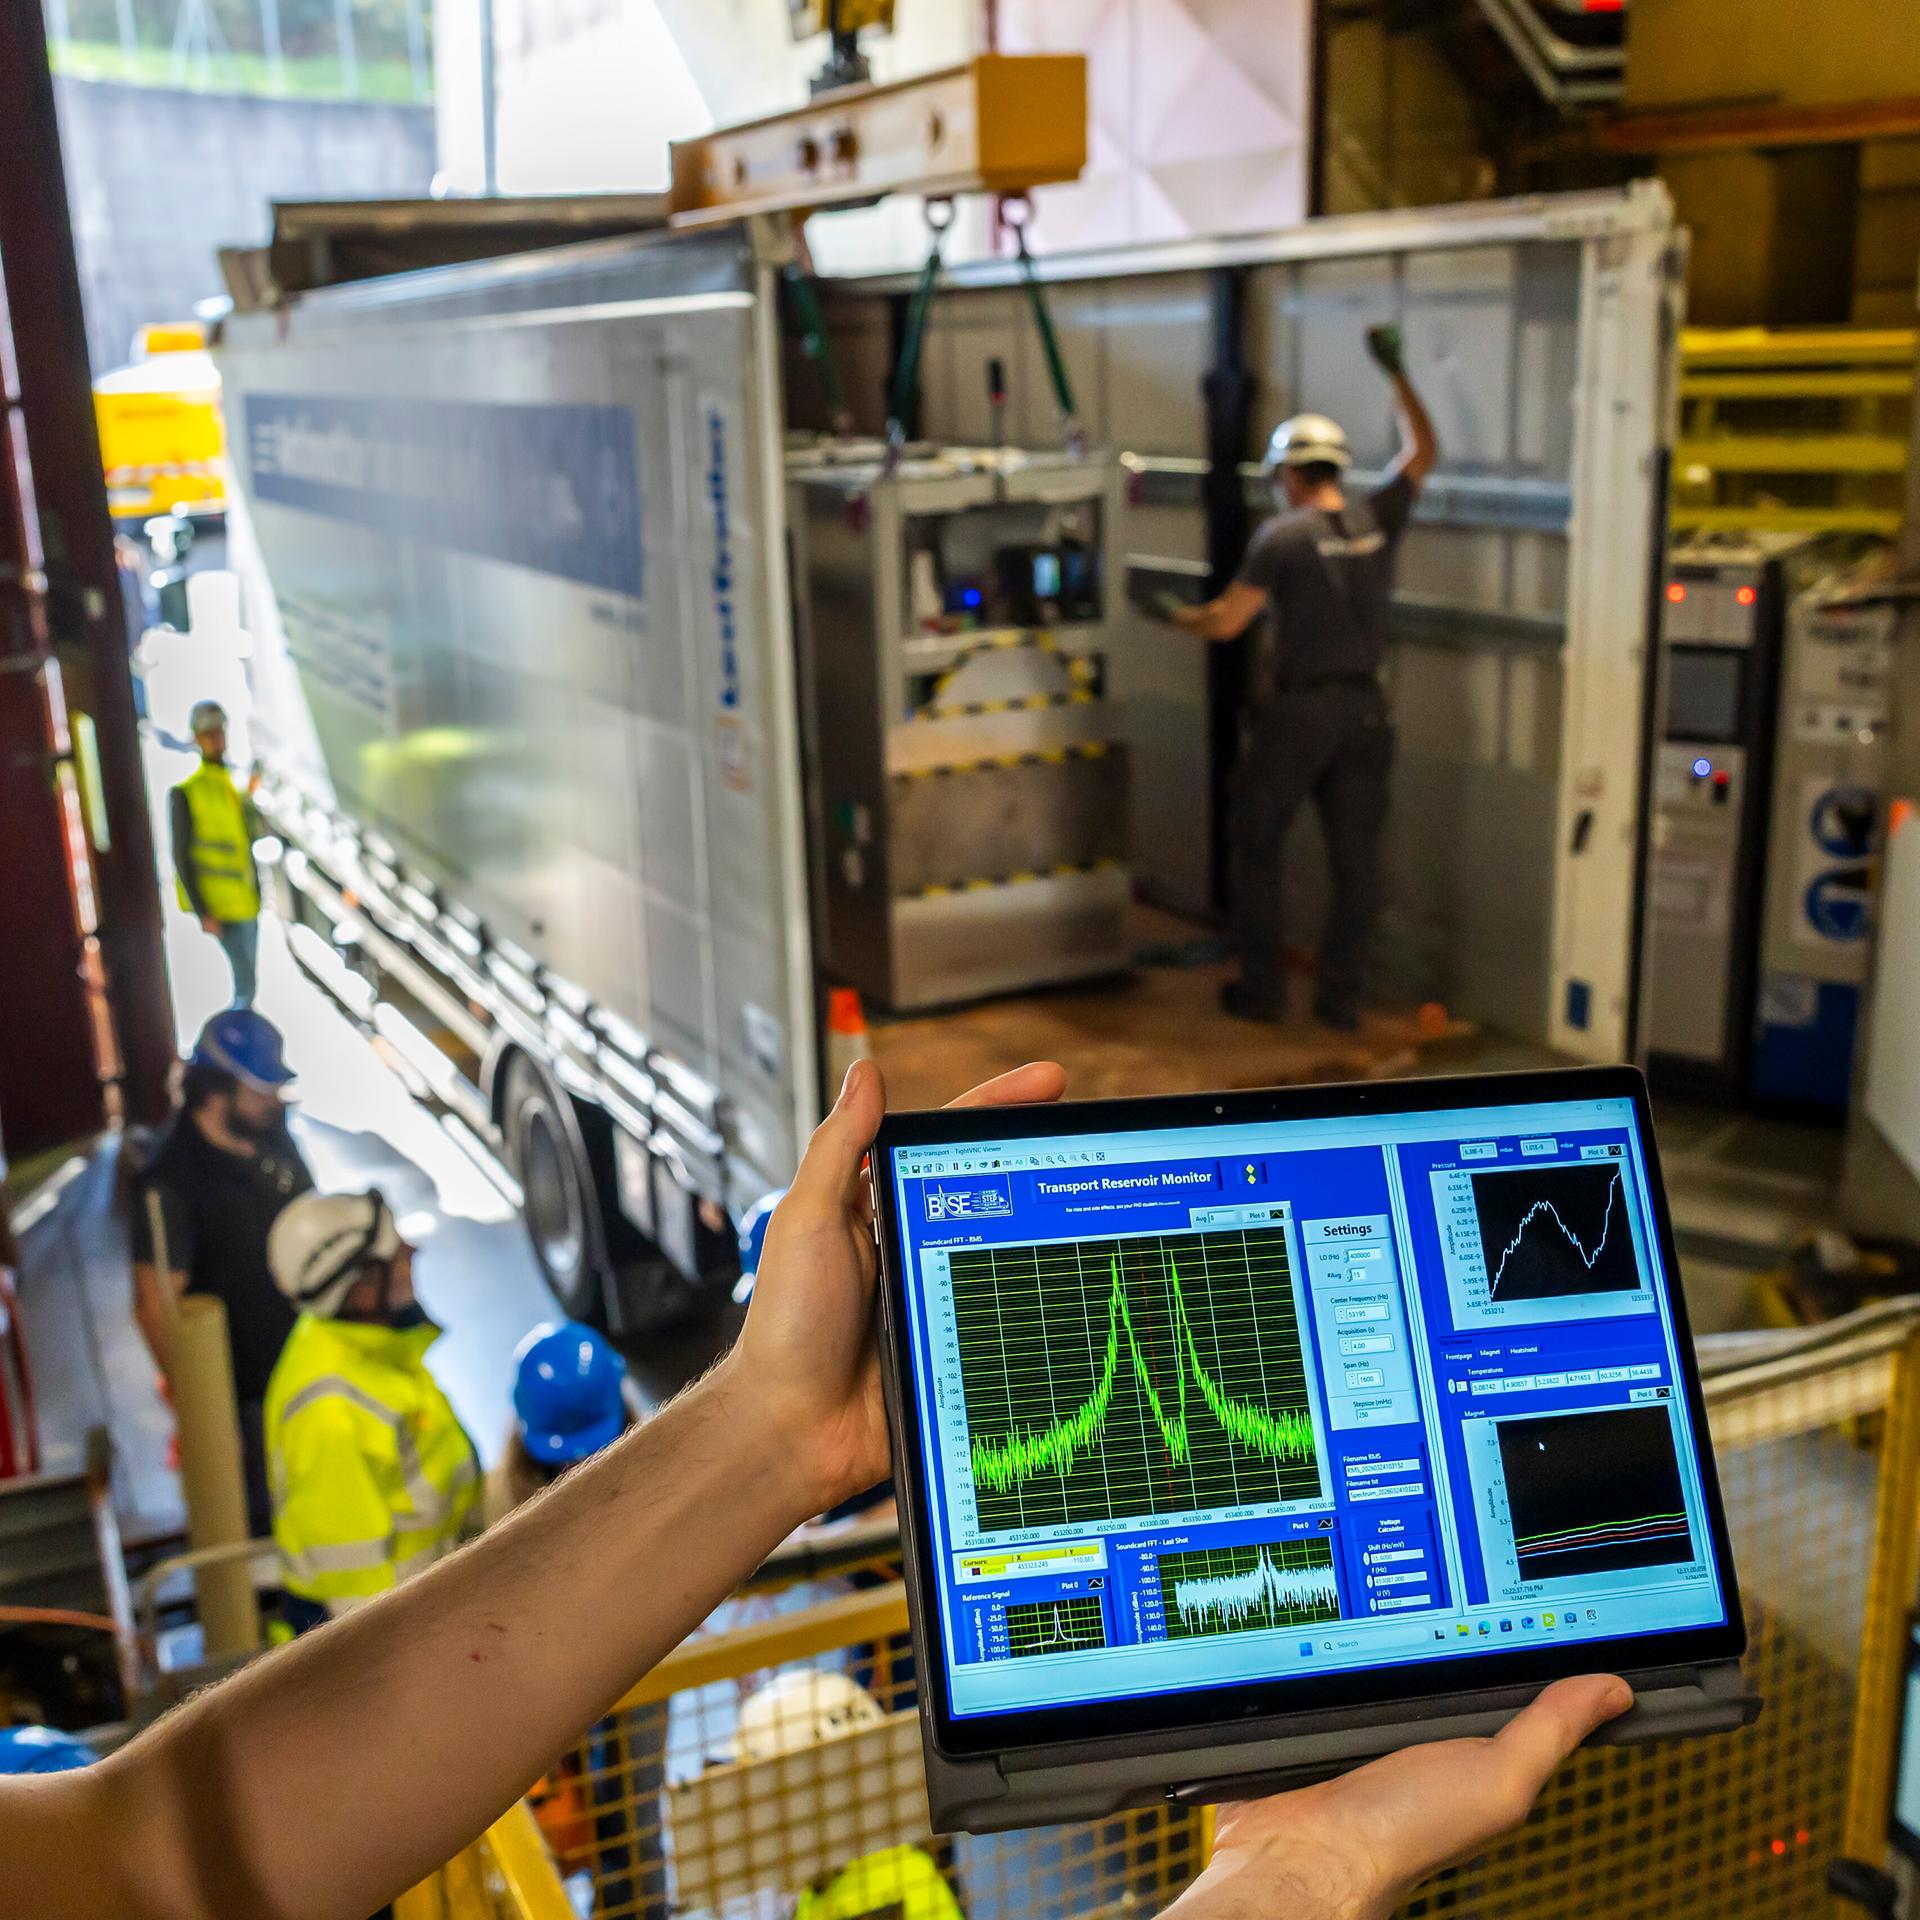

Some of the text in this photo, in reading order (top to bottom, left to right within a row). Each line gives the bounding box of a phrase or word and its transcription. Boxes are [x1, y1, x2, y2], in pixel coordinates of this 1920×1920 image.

[909, 1148, 949, 1157] step-transport
[954, 1146, 980, 1155] TightVNC
[1431, 1161, 1456, 1169] Pressure
[1037, 1170, 1212, 1196] Transport Reservoir Monitor
[981, 1194, 998, 1203] STEP
[1195, 1215, 1207, 1223] Avg
[1322, 1221, 1373, 1239] Settings
[921, 1237, 952, 1246] Soundcard
[953, 1236, 964, 1244] FFT
[1445, 1224, 1457, 1256] Amplitude
[1327, 1253, 1340, 1261] (Hz)
[1458, 1253, 1480, 1261] 6.05E-9
[1326, 1271, 1342, 1280] #Avg
[1330, 1296, 1348, 1304] Center
[1348, 1294, 1377, 1303] Frequency
[1348, 1310, 1366, 1318] 53195
[1481, 1307, 1505, 1315] 1253212
[1336, 1327, 1367, 1336] Acquisition
[1479, 1348, 1501, 1357] Magnet
[1509, 1345, 1538, 1354] Heatshield
[1444, 1351, 1473, 1362] Frontpage
[1467, 1365, 1504, 1376] Temperatures
[936, 1376, 946, 1408] Amplitude
[1636, 1390, 1647, 1398] Plot
[1352, 1399, 1374, 1408] Stepsize
[1464, 1409, 1485, 1418] Magnet
[953, 1450, 966, 1458] -112
[1342, 1452, 1382, 1462] Filename RMS
[955, 1466, 968, 1474] -114
[1345, 1478, 1370, 1487] Filename
[958, 1498, 971, 1506] -118
[1486, 1487, 1497, 1519] Amplitude
[960, 1514, 973, 1522] -120
[1223, 1509, 1254, 1518] 453400.000
[1292, 1522, 1304, 1530] Plot
[1379, 1518, 1400, 1526] Voltage
[1052, 1527, 1084, 1537] 453200.000
[1377, 1525, 1405, 1533] Calculator
[1115, 1535, 1188, 1550] Soundcard FFT Last Shot
[1367, 1541, 1405, 1551] Shift (Hz/mV)
[1138, 1552, 1153, 1560] -80.0
[1139, 1564, 1155, 1572] -90.0
[1374, 1565, 1387, 1574] (Hz)
[1138, 1576, 1156, 1584] -100.0
[1061, 1582, 1073, 1590] Plot
[962, 1589, 1010, 1602] Reference Signal
[1139, 1588, 1157, 1596] -110.0
[1381, 1588, 1391, 1596] (V)
[1130, 1591, 1140, 1611] (dBm)
[1140, 1600, 1159, 1608] -120.0
[991, 1603, 1001, 1611] 0.0
[973, 1607, 983, 1628] (dBm)
[986, 1613, 1002, 1622] -25.0
[1142, 1611, 1161, 1620] -130.0
[988, 1624, 1003, 1633] -50.0
[1143, 1623, 1162, 1632] -140.0
[989, 1634, 1004, 1643] -75.0
[1336, 1639, 1359, 1648] Search
[987, 1645, 1005, 1654] -100.0
